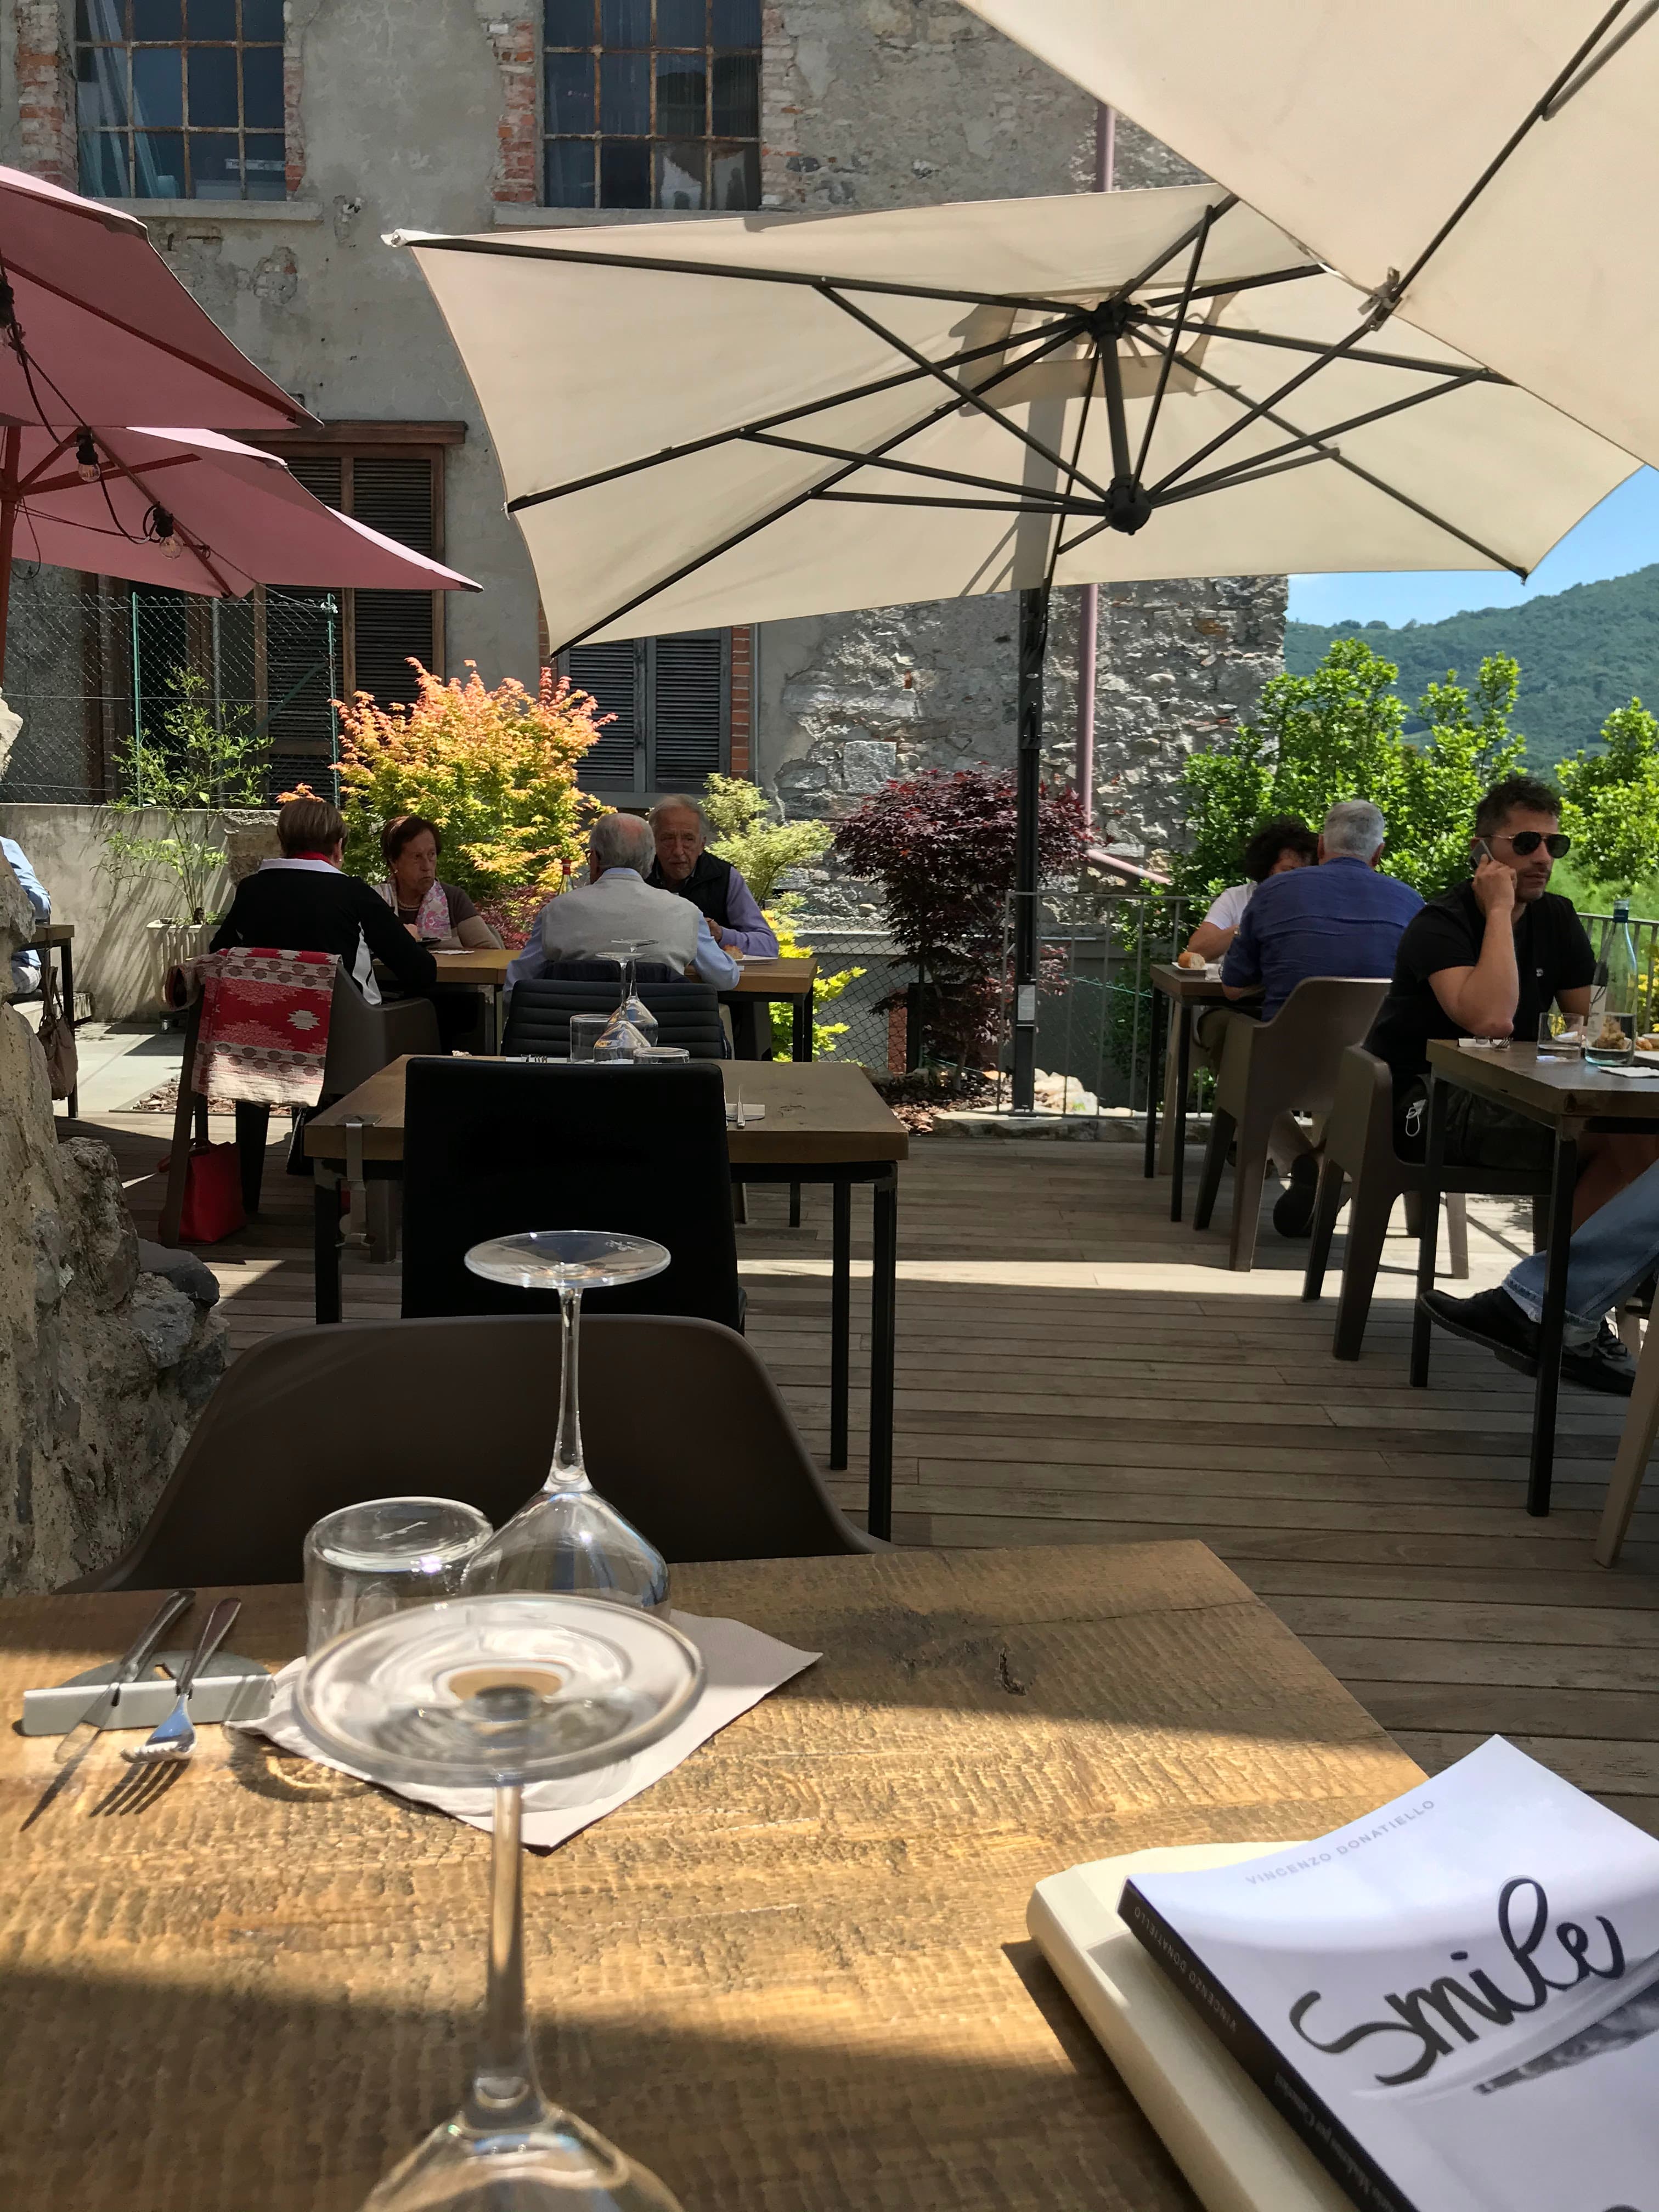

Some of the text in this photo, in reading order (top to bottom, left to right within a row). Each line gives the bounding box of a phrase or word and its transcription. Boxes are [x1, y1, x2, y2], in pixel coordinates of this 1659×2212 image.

[1245, 1800, 1435, 1885] VINCENZO DONATIELLO
[1134, 1906, 1236, 2032] VINCENZO DONATIELLO
[1289, 1875, 1625, 2085] Smile
